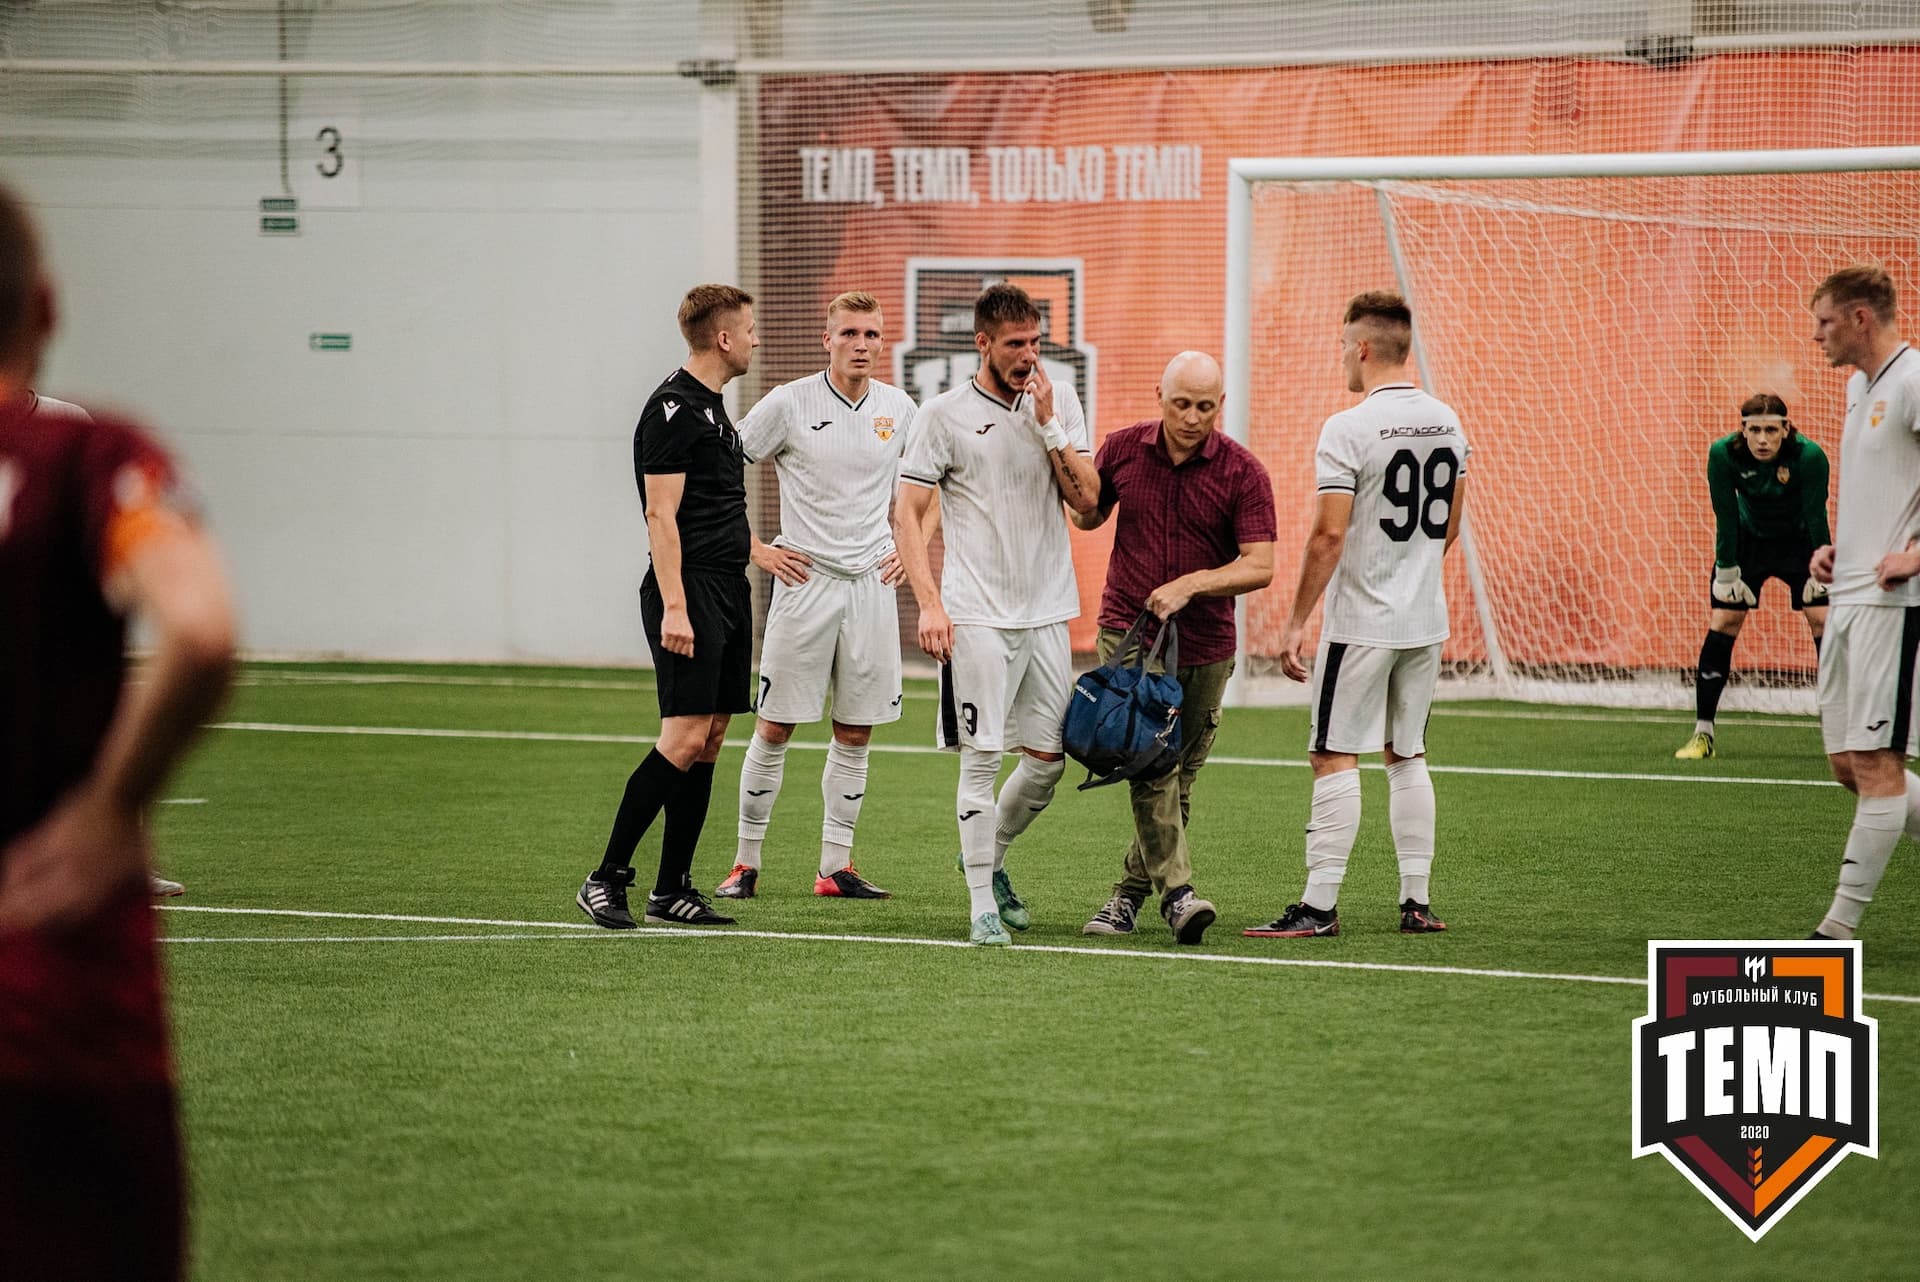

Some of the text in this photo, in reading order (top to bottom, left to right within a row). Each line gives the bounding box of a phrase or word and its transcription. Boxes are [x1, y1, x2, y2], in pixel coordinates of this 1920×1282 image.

[315, 127, 344, 179] 3
[801, 145, 1203, 209] ТЕМП, ТЕМП, ТОЛЬКО ТЕМП!
[1379, 447, 1459, 542] 98
[961, 702, 978, 737] 9
